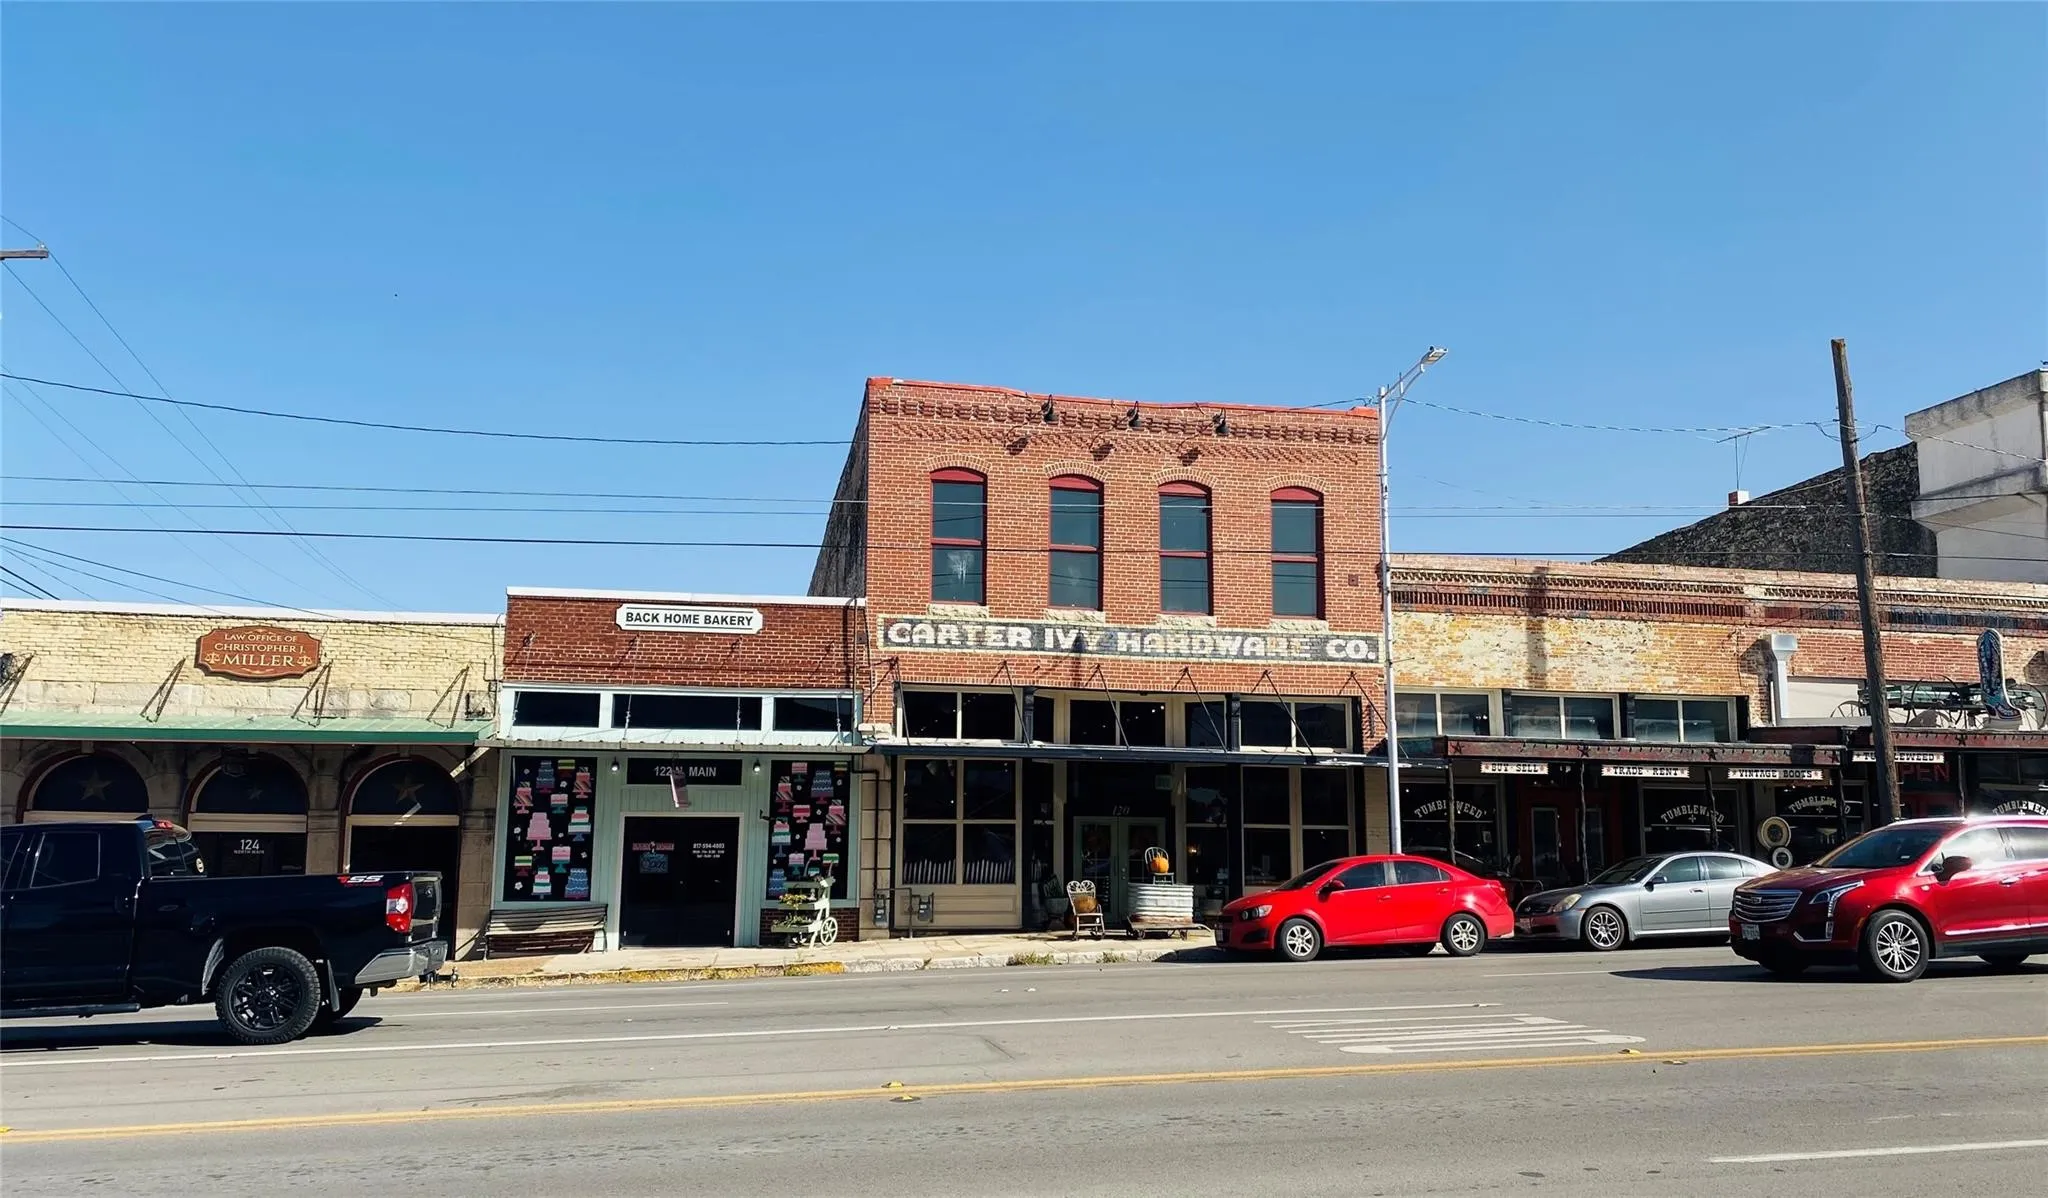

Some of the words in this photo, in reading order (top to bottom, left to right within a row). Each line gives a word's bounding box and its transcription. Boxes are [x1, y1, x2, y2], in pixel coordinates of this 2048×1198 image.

[626, 612, 660, 623] BACK
[664, 613, 700, 624] HOME
[703, 614, 753, 626] BAKERY
[224, 633, 246, 641] LAW
[247, 634, 282, 642] OFFICE
[284, 635, 298, 643] OF
[887, 622, 1032, 648] CARTER
[1044, 627, 1104, 651] IVY
[1116, 631, 1312, 658] HARDWARE
[1325, 639, 1377, 660] CO.
[214, 643, 297, 653] CHRISTOPHER
[299, 645, 306, 654] J.
[222, 653, 295, 667] MILLER
[655, 766, 673, 777] 122
[688, 766, 717, 777] MAIN
[1491, 763, 1509, 772] BUY
[1516, 764, 1539, 773] SELL
[1613, 766, 1644, 775] TRADE
[1652, 767, 1679, 776] RENT
[1739, 769, 1777, 778] VINTAGE
[1902, 763, 1951, 782] PEN
[1992, 800, 2048, 817] TUMBLEWEE
[240, 839, 260, 850] 124
